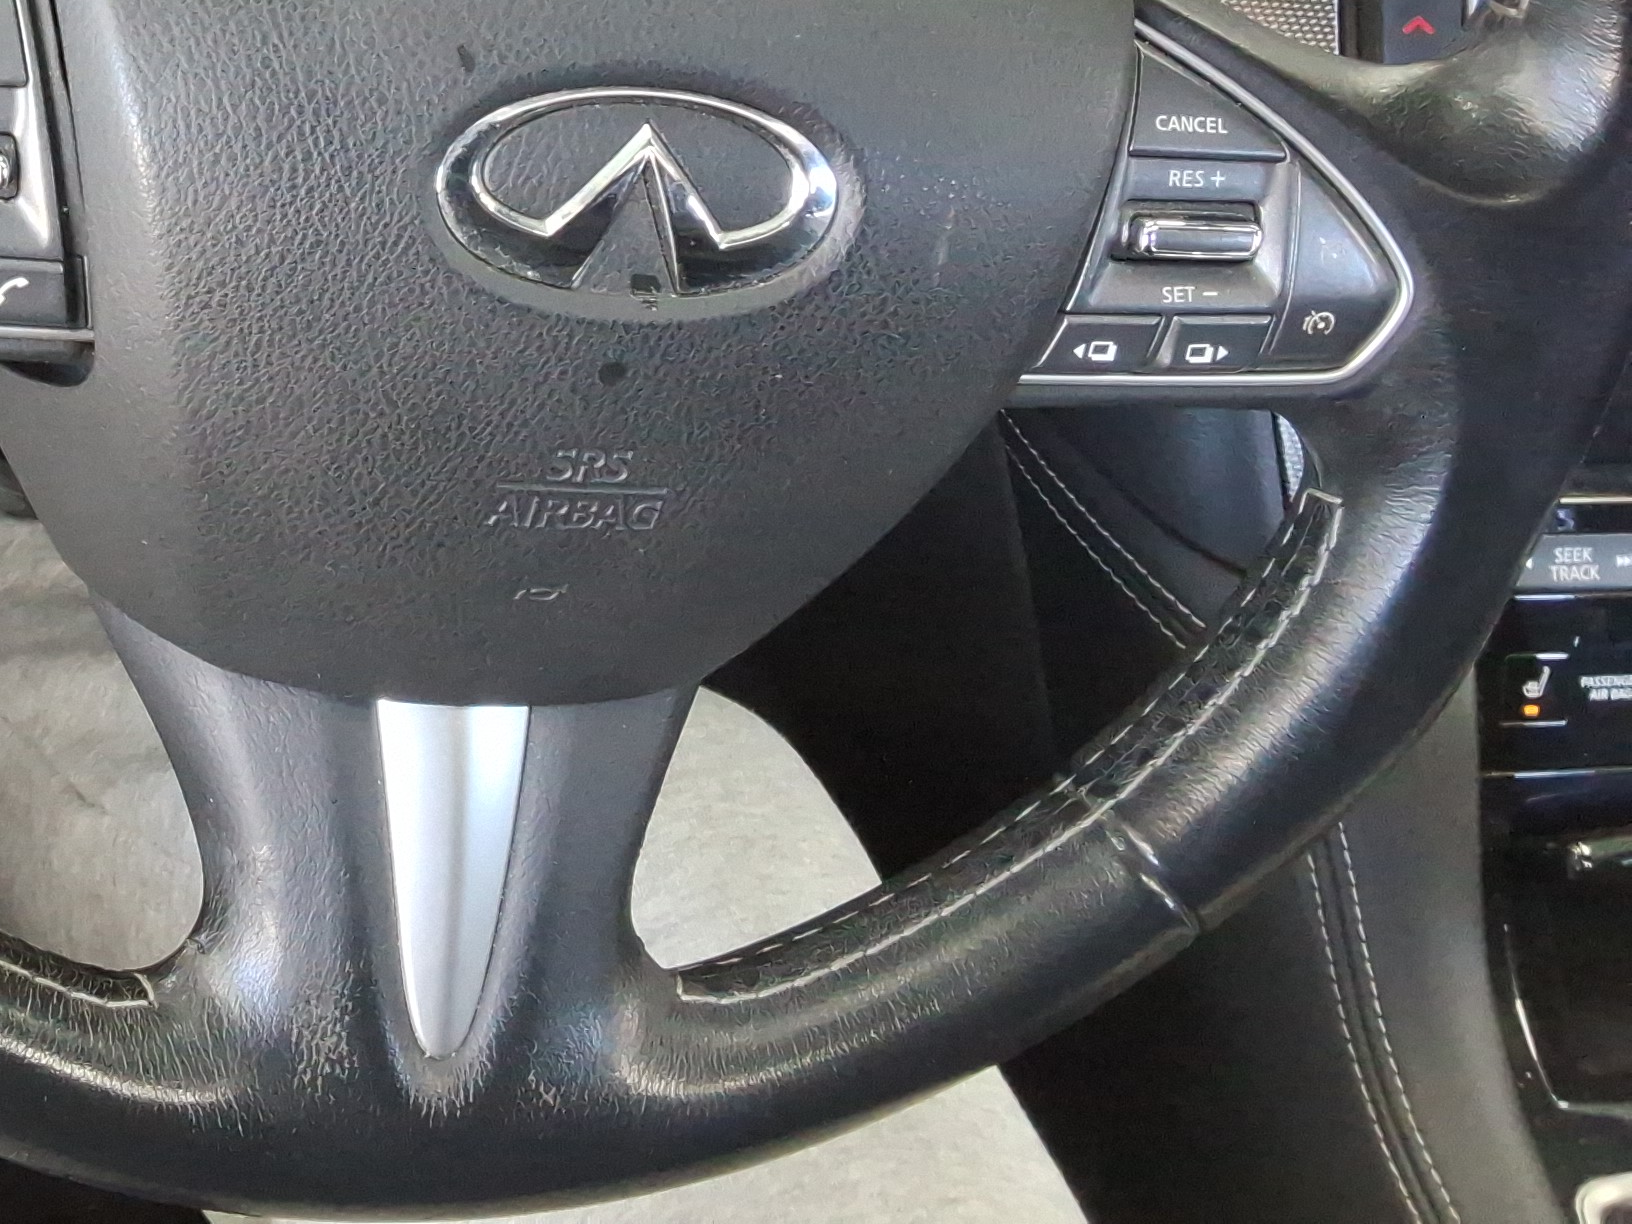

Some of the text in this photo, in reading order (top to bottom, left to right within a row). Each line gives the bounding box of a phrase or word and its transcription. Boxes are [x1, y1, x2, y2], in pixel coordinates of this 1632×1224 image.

[1155, 115, 1228, 134] CANCEL
[546, 447, 635, 484] SRS
[483, 495, 664, 532] AIRBAG
[1554, 547, 1593, 563] SEEK
[1550, 565, 1601, 581] TRACK
